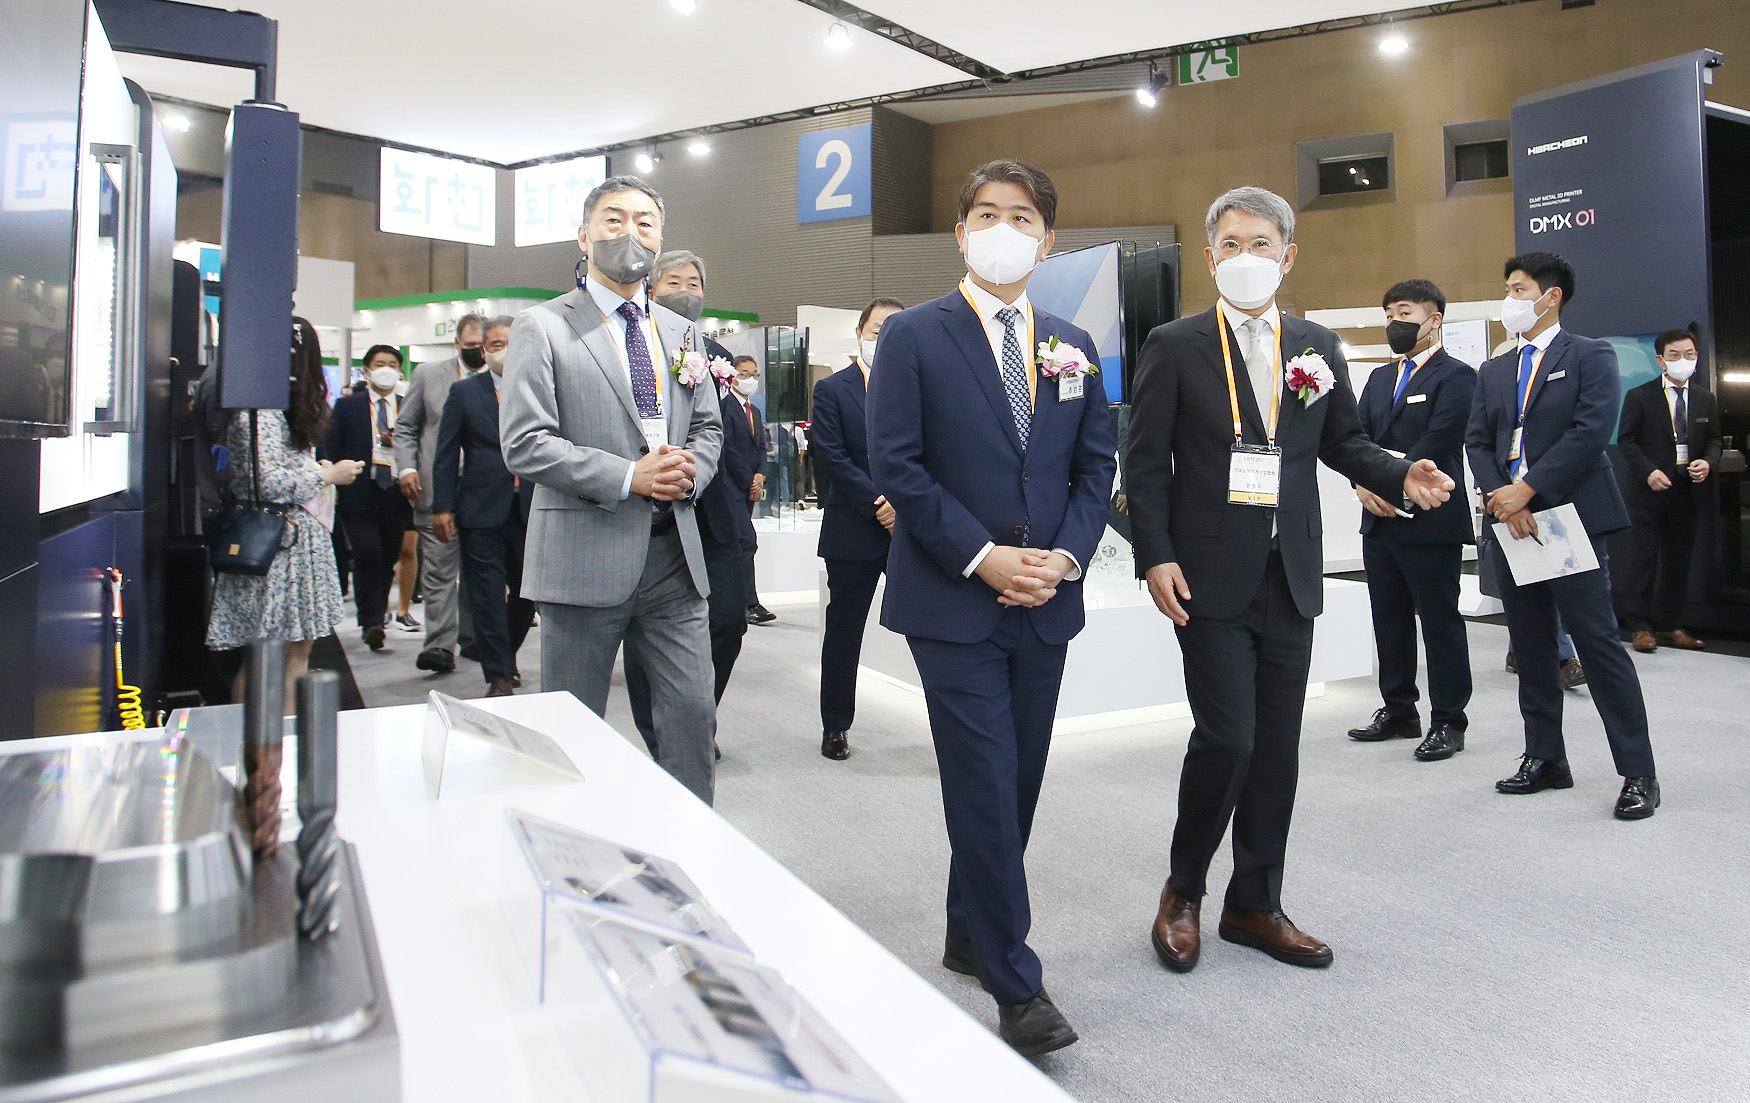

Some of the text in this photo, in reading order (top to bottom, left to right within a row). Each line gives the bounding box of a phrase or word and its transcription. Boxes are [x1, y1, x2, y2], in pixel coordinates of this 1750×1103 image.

[1528, 135, 1588, 155] HWACHEON
[815, 139, 853, 211] 2
[1564, 189, 1583, 197] PRINTER
[1529, 208, 1595, 234] DMX 01
